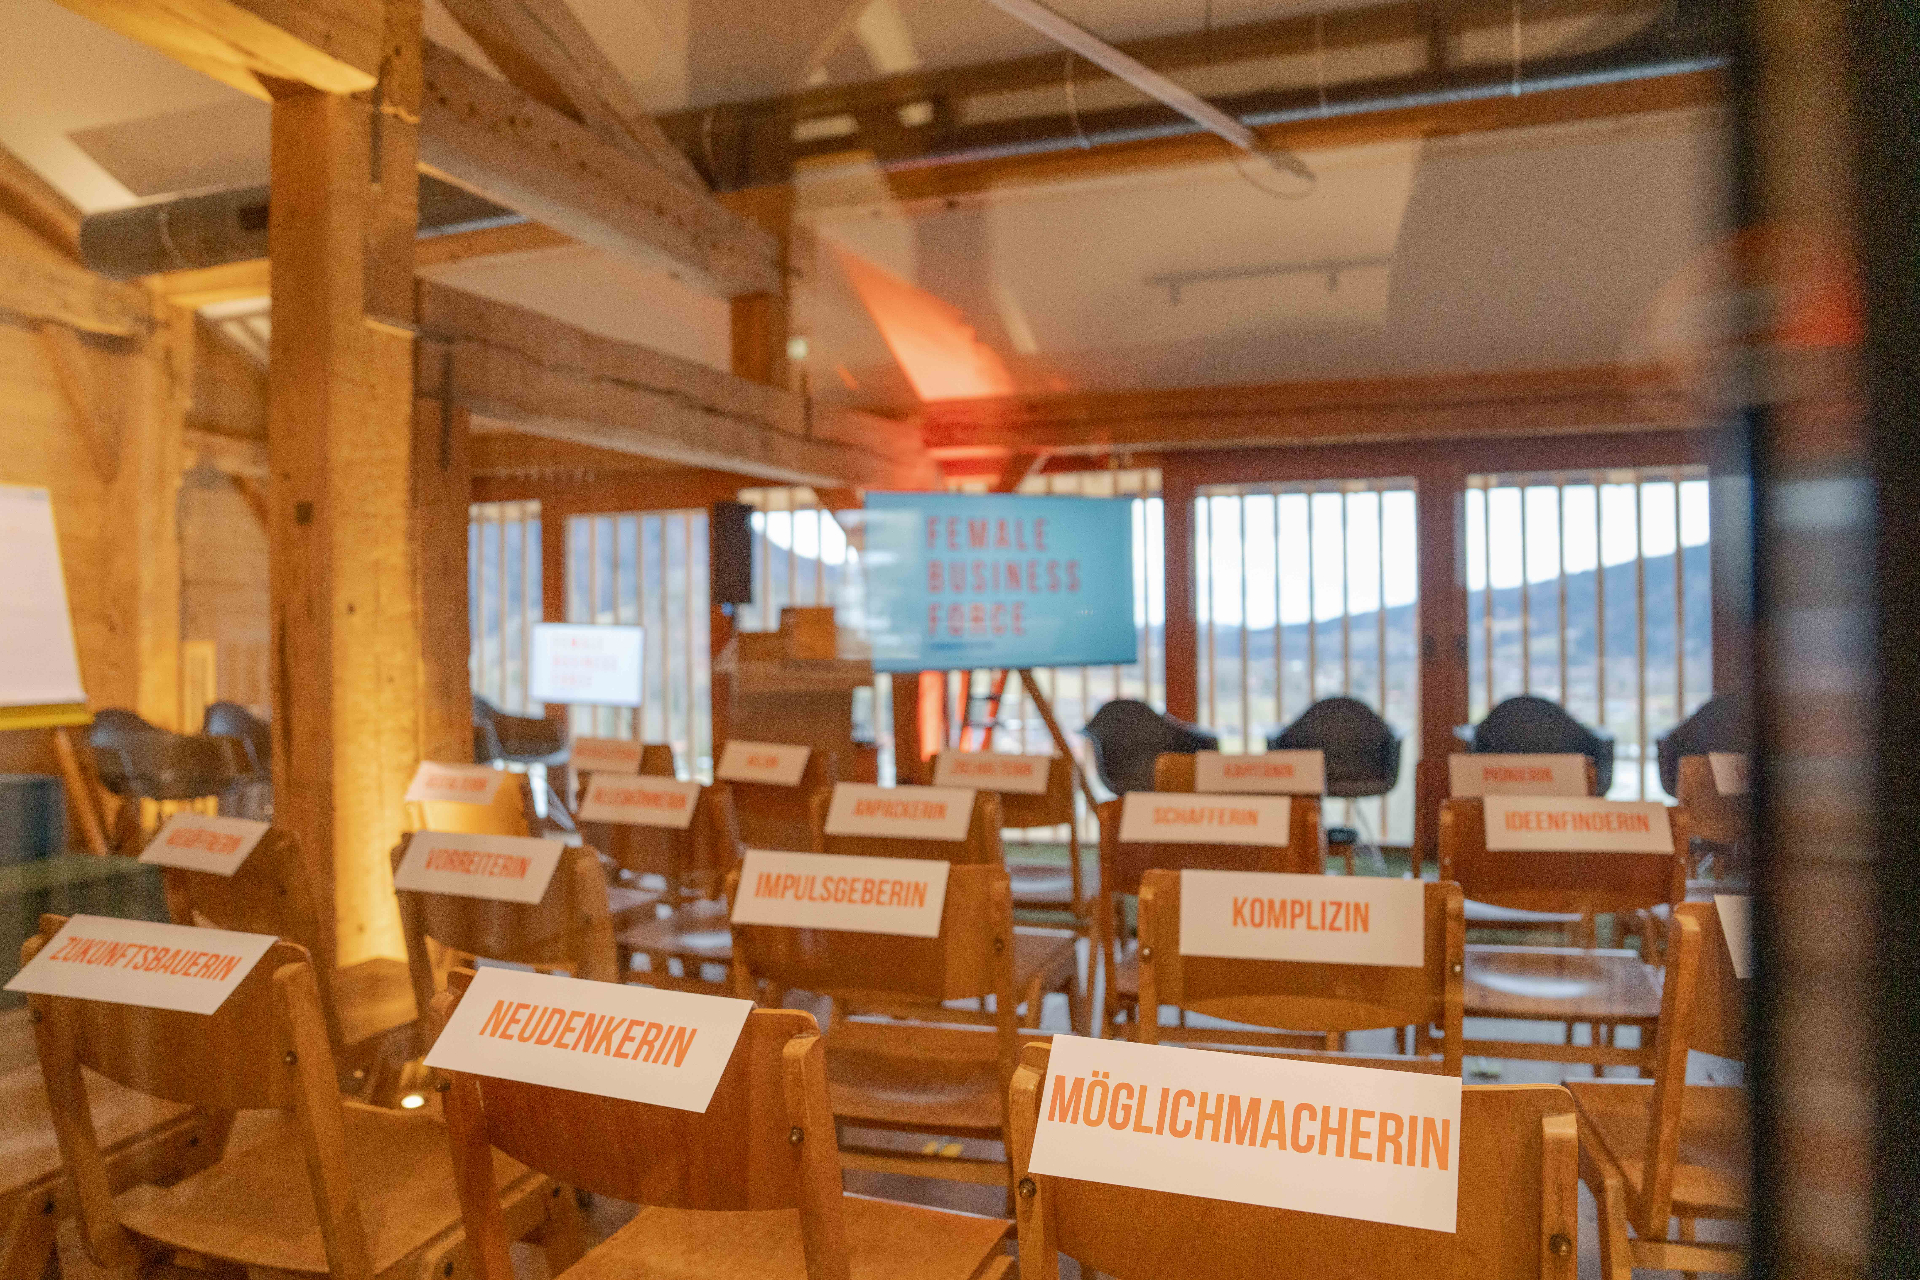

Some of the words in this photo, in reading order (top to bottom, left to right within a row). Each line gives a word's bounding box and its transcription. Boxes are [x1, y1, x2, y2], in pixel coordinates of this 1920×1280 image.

[926, 515, 1048, 551] FEMALE
[926, 558, 1081, 593] BUSINESS
[927, 601, 1026, 636] FORCE
[1505, 811, 1650, 832] IDEENFINDERIN
[754, 872, 929, 908] IMPULSGEBERIN
[1232, 897, 1370, 932] KOMPLIZIN
[49, 936, 243, 982] ZUKUNFTSBAUERIN
[478, 1000, 698, 1068] NEUDENKERIN
[1047, 1070, 1451, 1171] MÖGLICHMACHERIN
